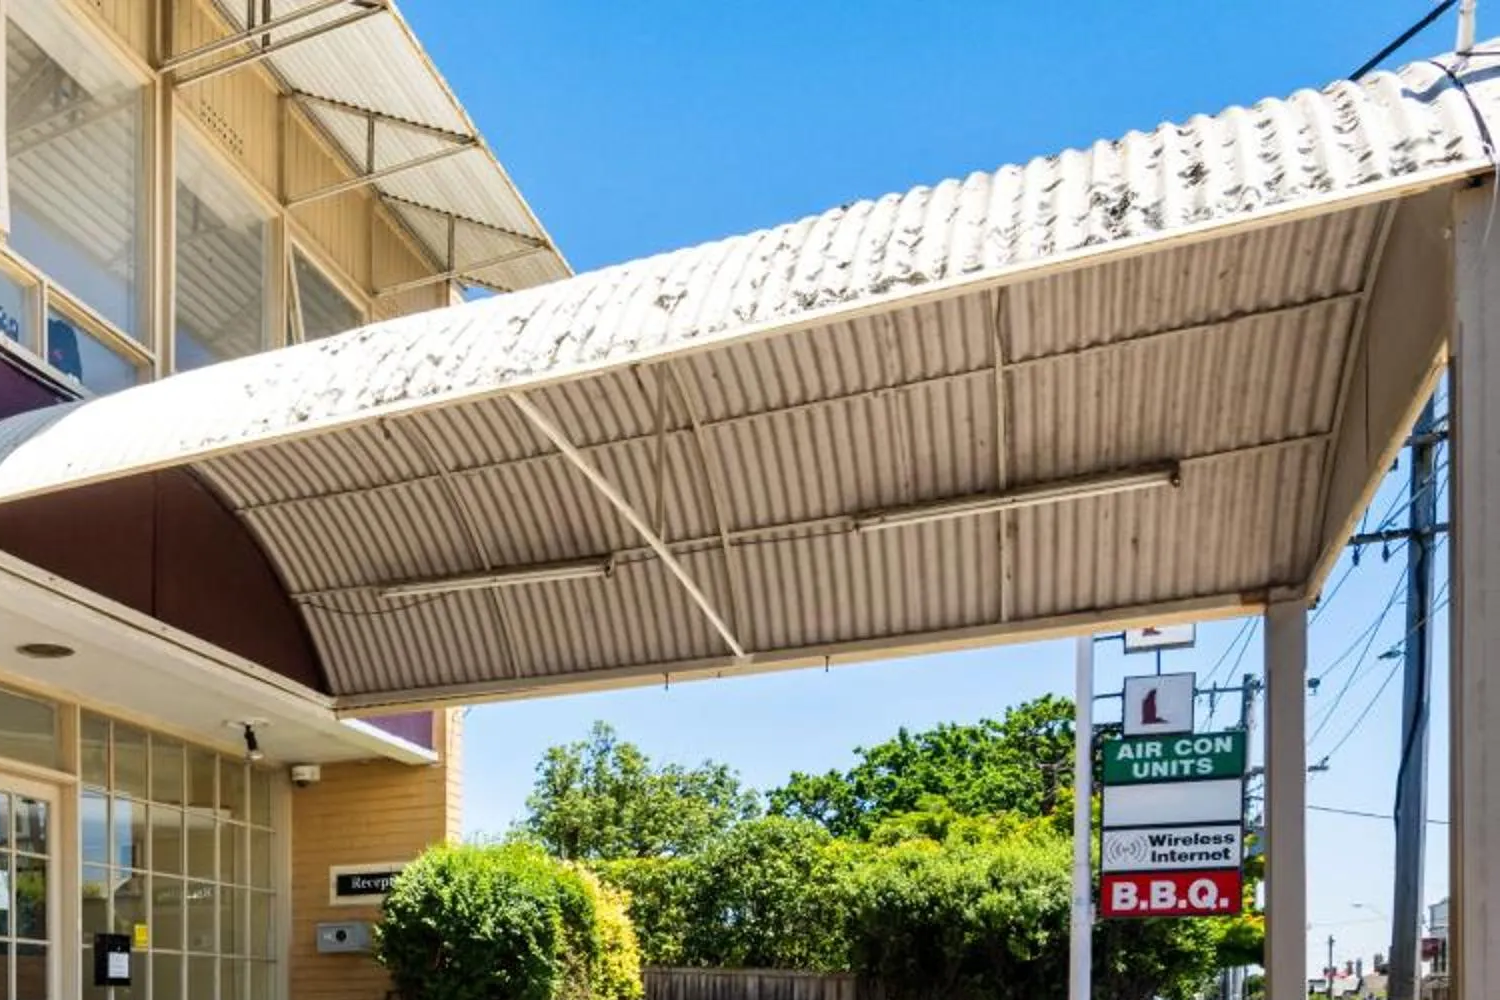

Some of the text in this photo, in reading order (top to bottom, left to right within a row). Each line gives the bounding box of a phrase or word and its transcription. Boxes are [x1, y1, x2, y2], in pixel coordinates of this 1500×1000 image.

[1116, 735, 1233, 761] AIR CON
[1132, 757, 1214, 779] UNITS
[1148, 833, 1235, 847] Wireless
[1151, 847, 1231, 863] Internet
[351, 876, 395, 891] Recept
[1111, 878, 1229, 911] B.B.Q.
